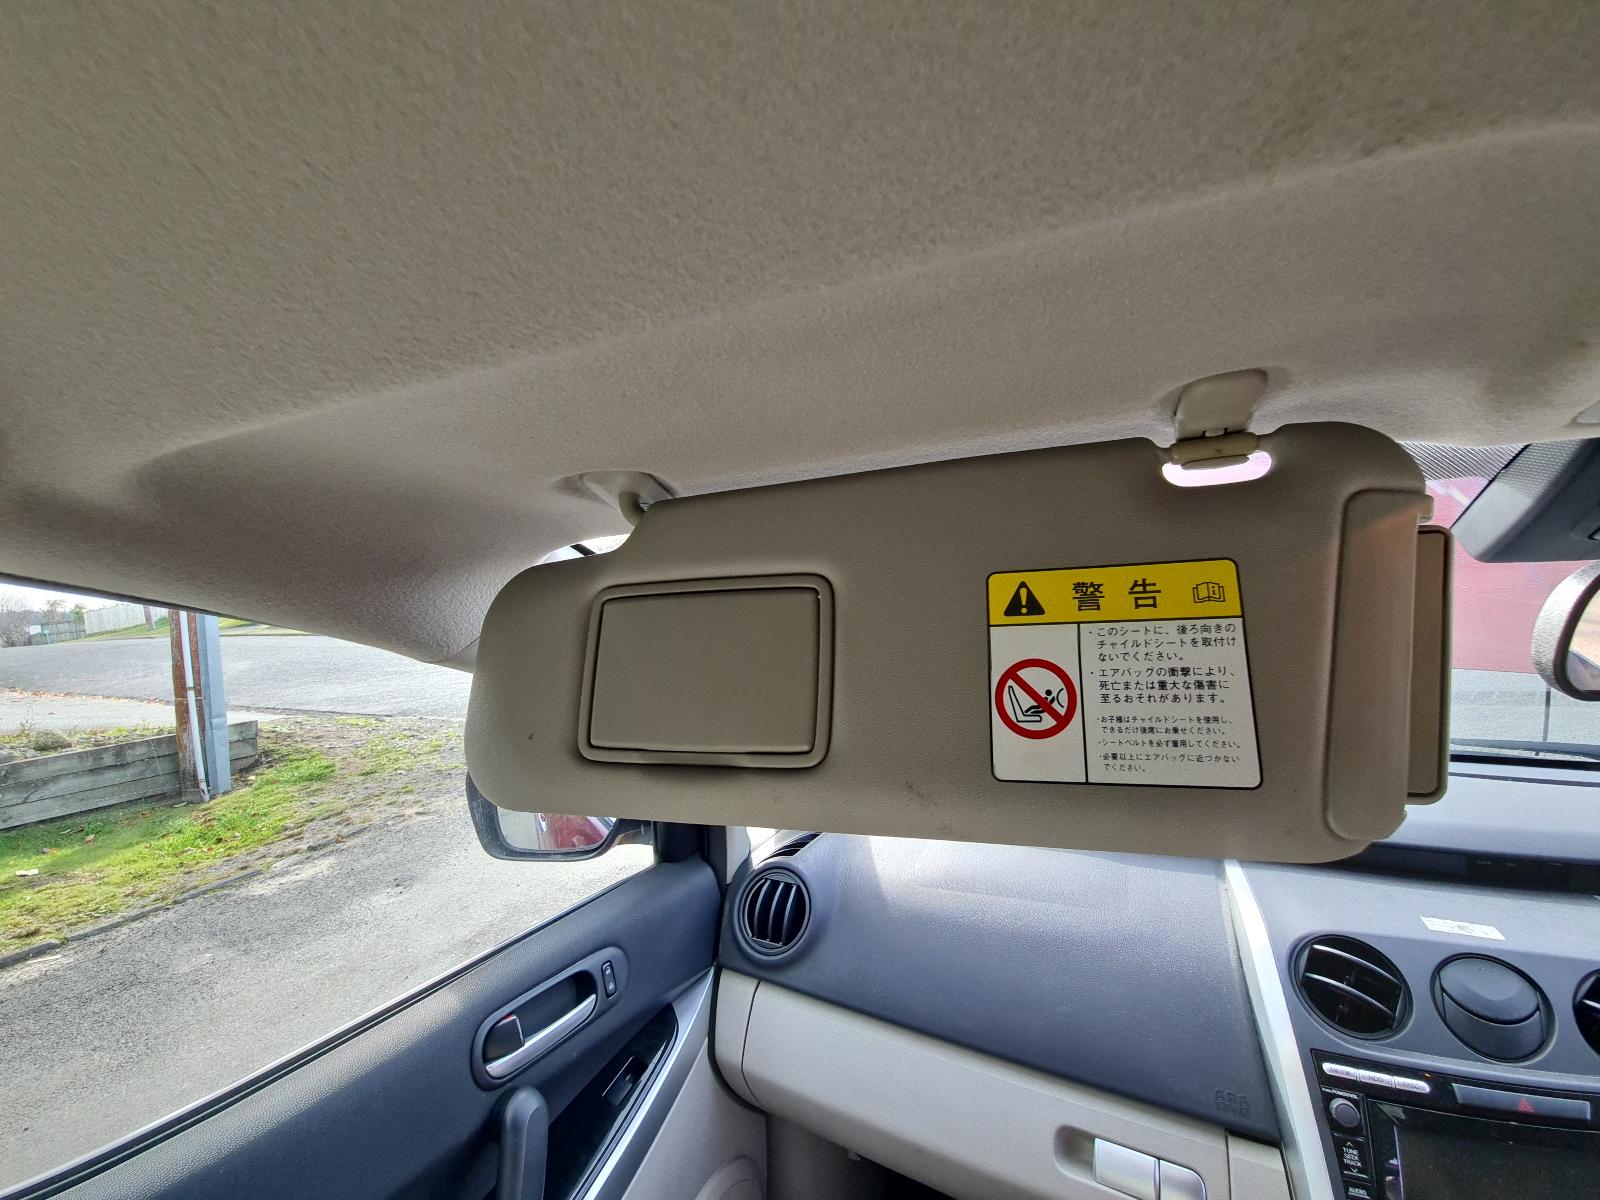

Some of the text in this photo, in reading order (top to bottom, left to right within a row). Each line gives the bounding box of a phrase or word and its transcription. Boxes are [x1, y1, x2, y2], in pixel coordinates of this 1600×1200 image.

[1097, 637, 1236, 649] チャイルドシートを取付け
[1098, 651, 1184, 662] ないでください。
[1099, 680, 1230, 691] 死亡または重大な傷害に
[1100, 693, 1226, 704] 至るおそれがあります。
